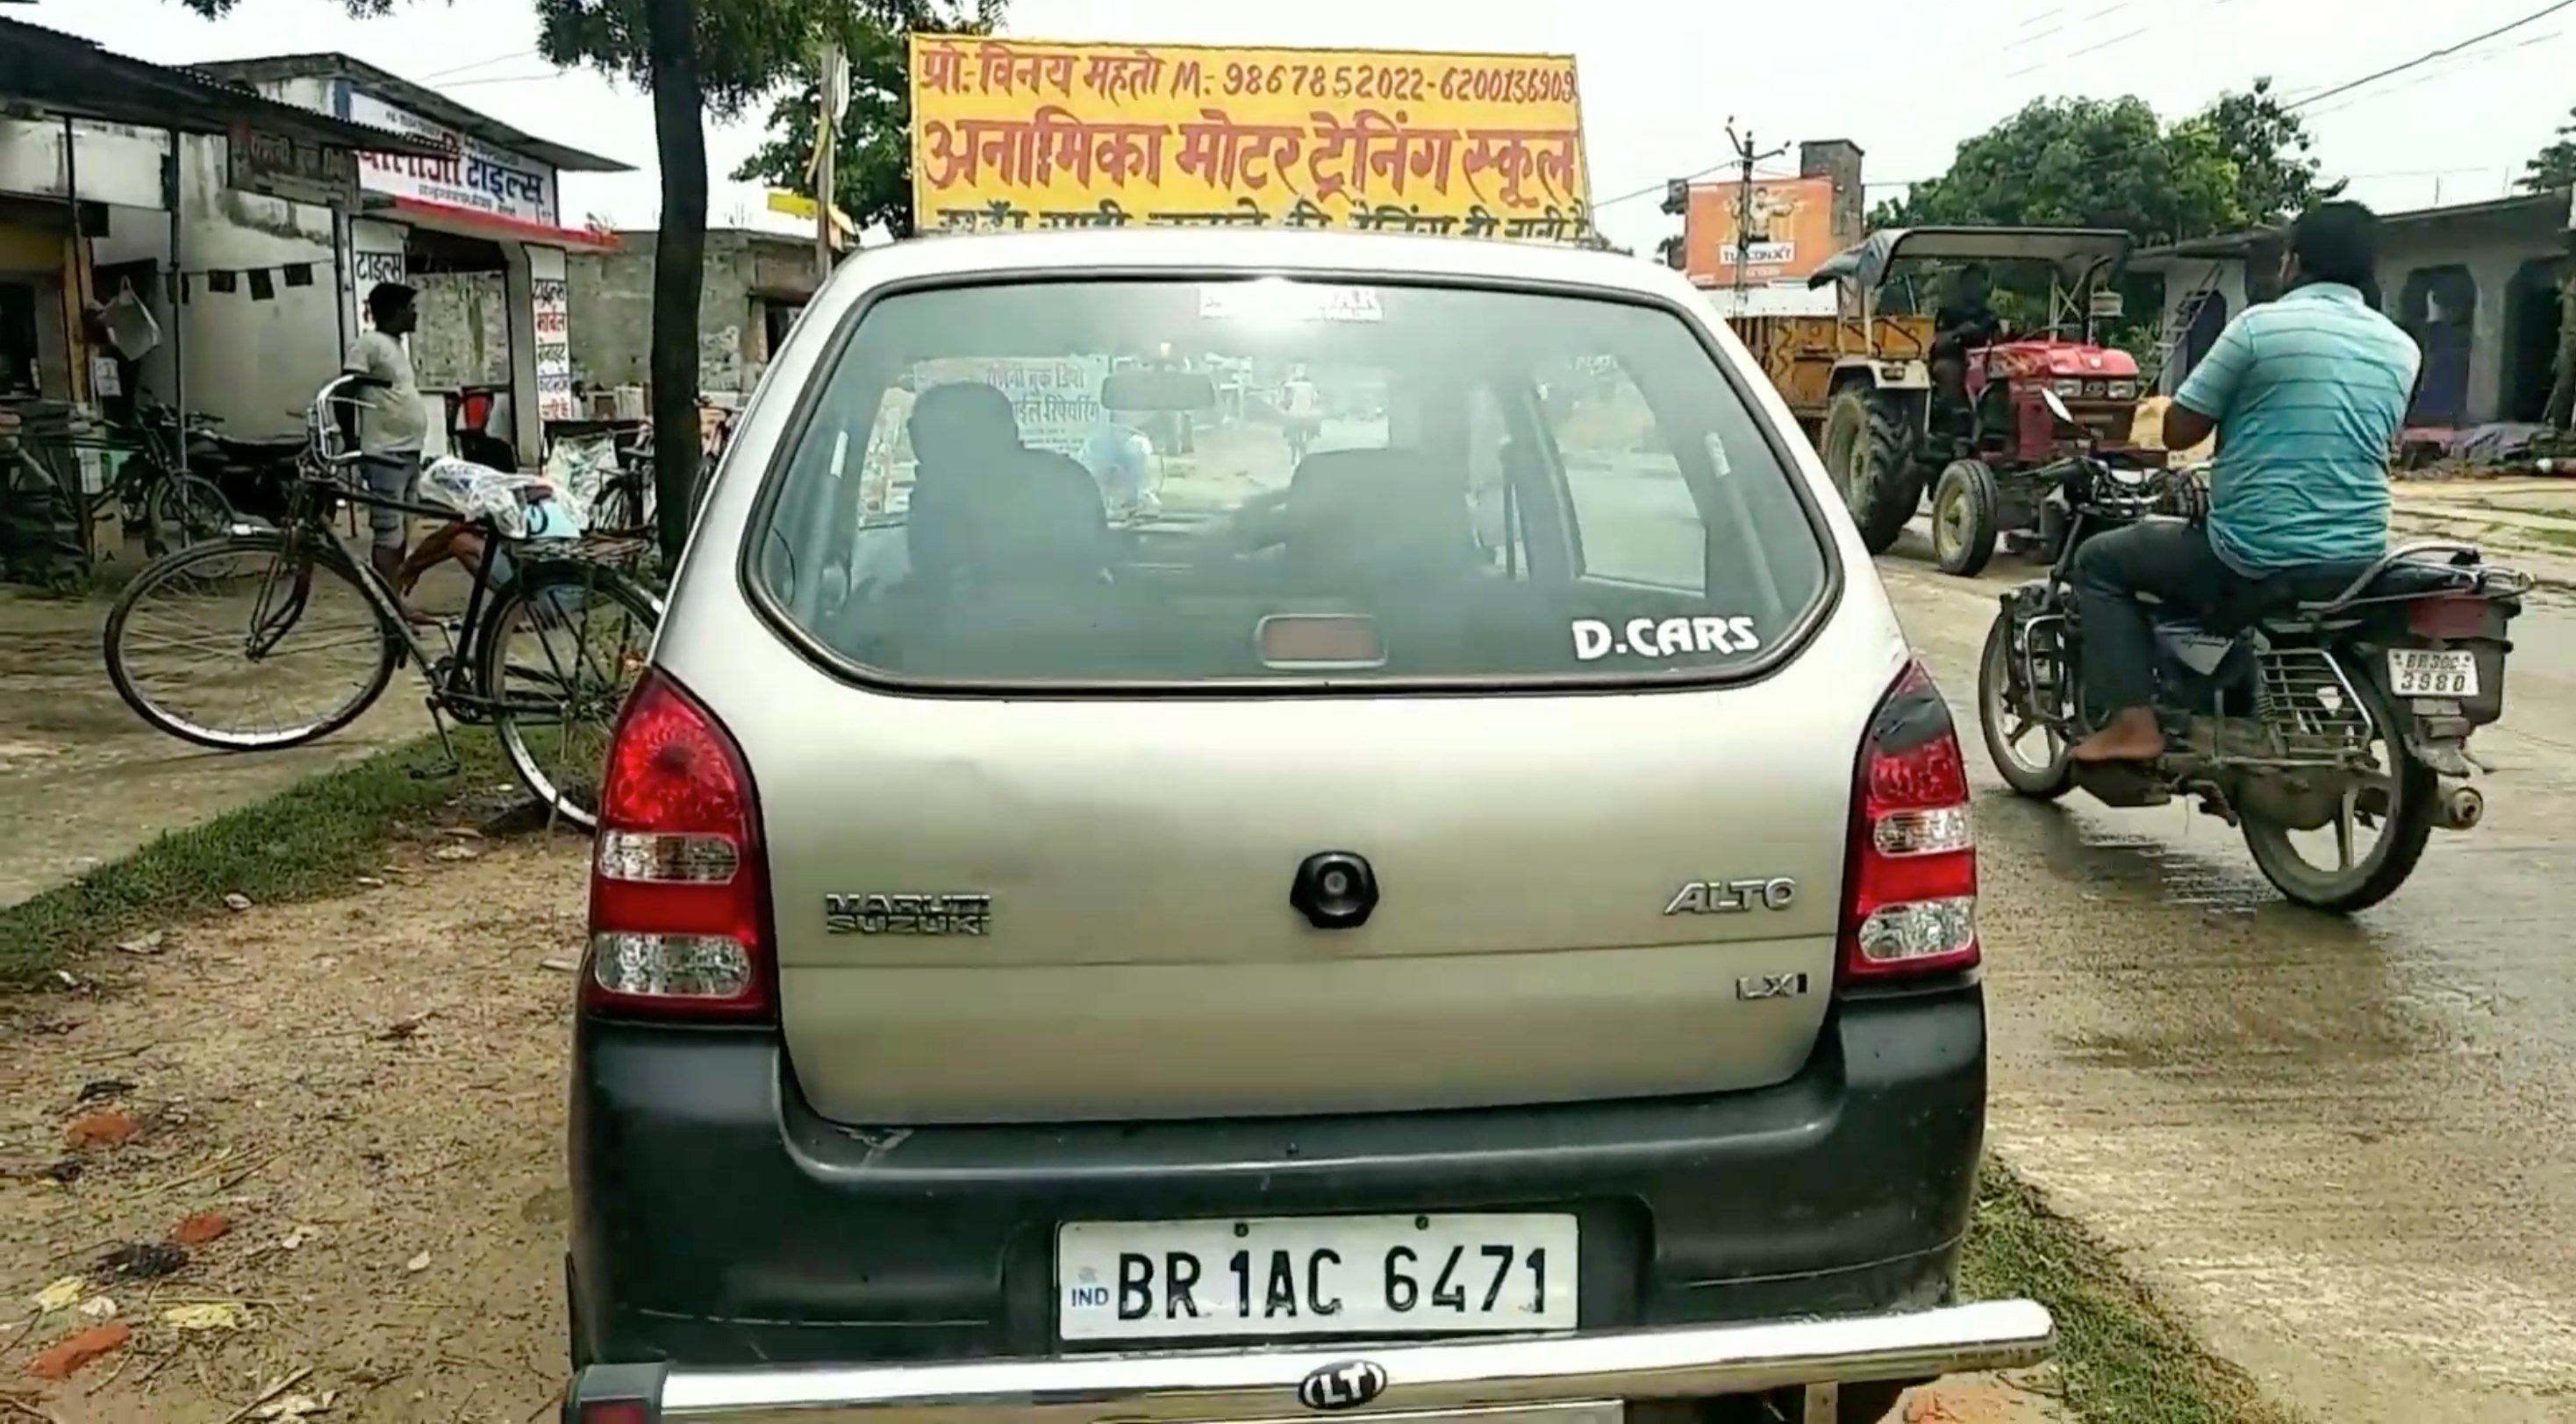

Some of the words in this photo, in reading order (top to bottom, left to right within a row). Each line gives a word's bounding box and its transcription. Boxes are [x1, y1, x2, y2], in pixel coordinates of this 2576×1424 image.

[976, 42, 1080, 97] विनय
[1083, 49, 1167, 106] महतो
[924, 105, 1171, 189] अनामिका
[1177, 109, 1306, 195] मोटर
[1309, 109, 1463, 204] ट्रेनिंग
[1463, 129, 1579, 209] स्कूल
[468, 154, 544, 204] टाइल्स
[1571, 616, 1760, 660] D.CARS
[2401, 672, 2466, 692] 3980
[826, 893, 991, 914] MARUTI
[1663, 877, 1796, 915] ALTO
[826, 914, 991, 934] SUZUKI
[1071, 1287, 1109, 1307] IND
[1118, 1252, 1201, 1320] BR
[1229, 1249, 1344, 1318] 1AC
[1384, 1245, 1546, 1314] 6471
